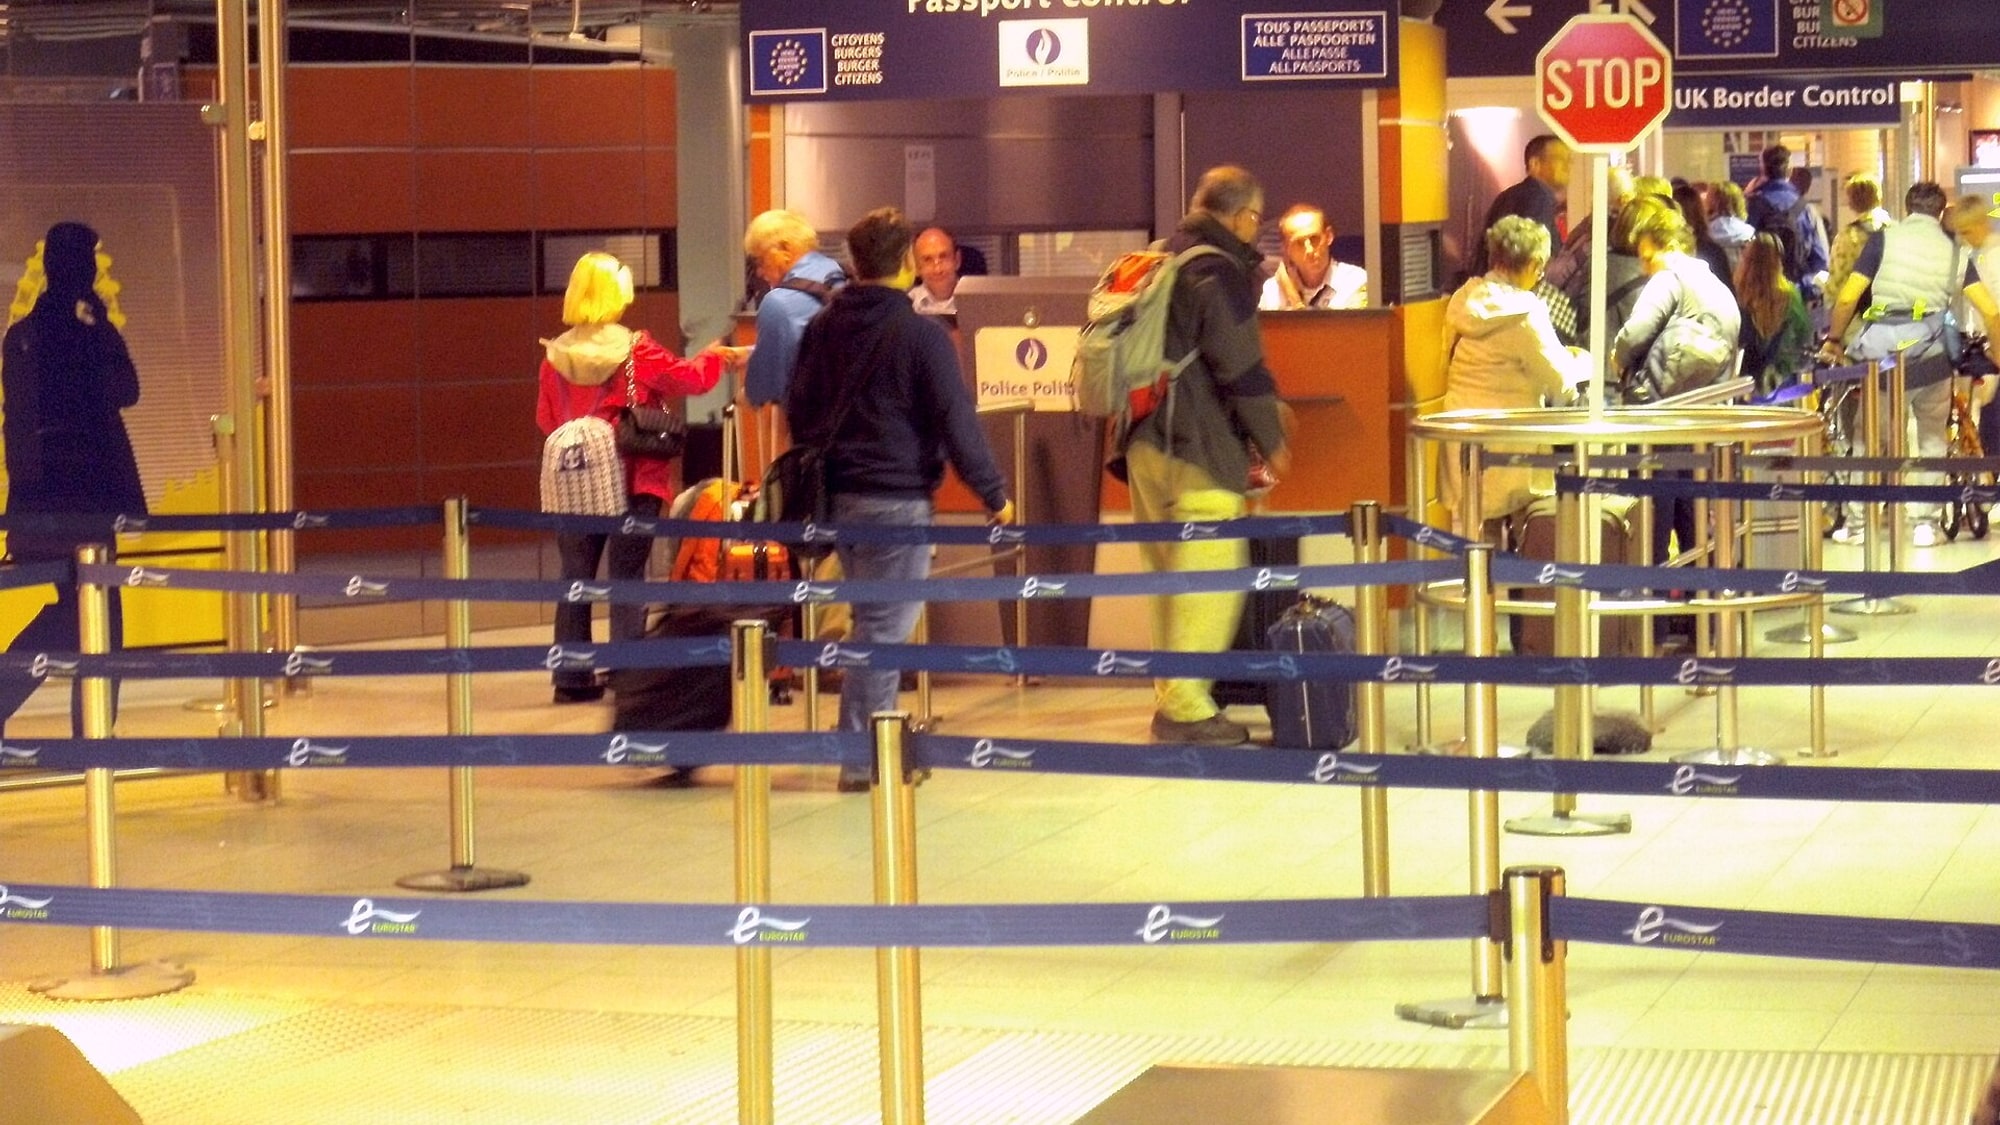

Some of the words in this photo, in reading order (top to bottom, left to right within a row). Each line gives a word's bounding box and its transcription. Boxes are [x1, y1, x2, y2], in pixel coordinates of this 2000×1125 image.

[1255, 20, 1291, 34] TOUS
[1293, 19, 1374, 33] PASSEPORTS
[831, 32, 885, 47] CITOYENS
[1253, 35, 1285, 48] ALLE
[1290, 33, 1376, 47] PASPOORTEN
[834, 46, 882, 60] BURGERS
[1281, 48, 1310, 60] ALLE
[1312, 47, 1349, 59] PASSE
[837, 59, 880, 72] BURGER
[1269, 61, 1292, 74] ALL
[1292, 59, 1361, 73] PASSPORTS
[834, 71, 883, 86] CITIZENS
[1546, 57, 1661, 110] STOP
[1675, 88, 1709, 110] UK
[1713, 85, 1796, 109] Border
[1802, 82, 1894, 107] Control
[981, 381, 1028, 396] Police
[1033, 380, 1076, 396] Polit
[8, 908, 48, 919] EUROSTAR
[372, 922, 416, 934] EUROSTAR
[1171, 929, 1219, 940] EUROSTAR
[759, 931, 805, 942] EUROSTAR
[1663, 933, 1715, 946] EUROSTAR
